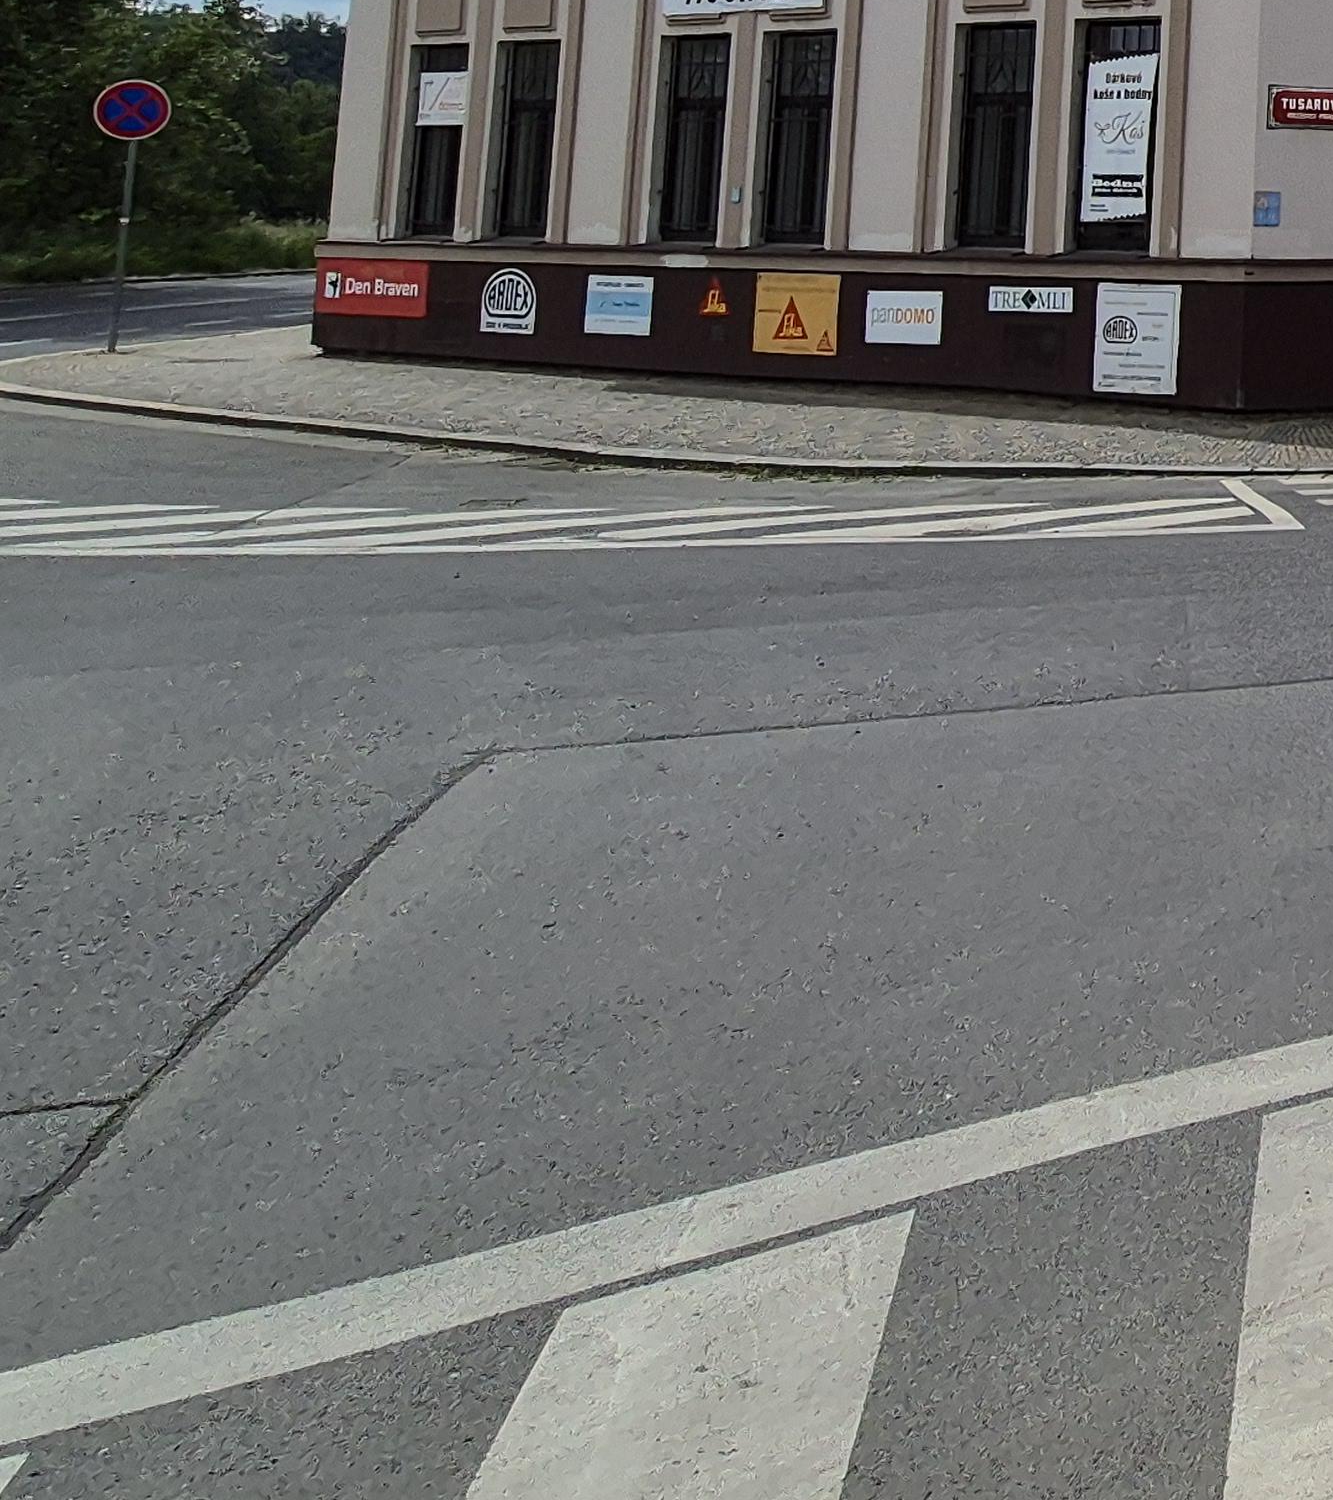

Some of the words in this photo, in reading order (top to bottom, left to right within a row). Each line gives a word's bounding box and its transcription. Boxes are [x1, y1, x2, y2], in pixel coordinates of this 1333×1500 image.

[344, 277, 371, 295] Den
[375, 278, 419, 298] Braven
[487, 277, 531, 312] ARDEX
